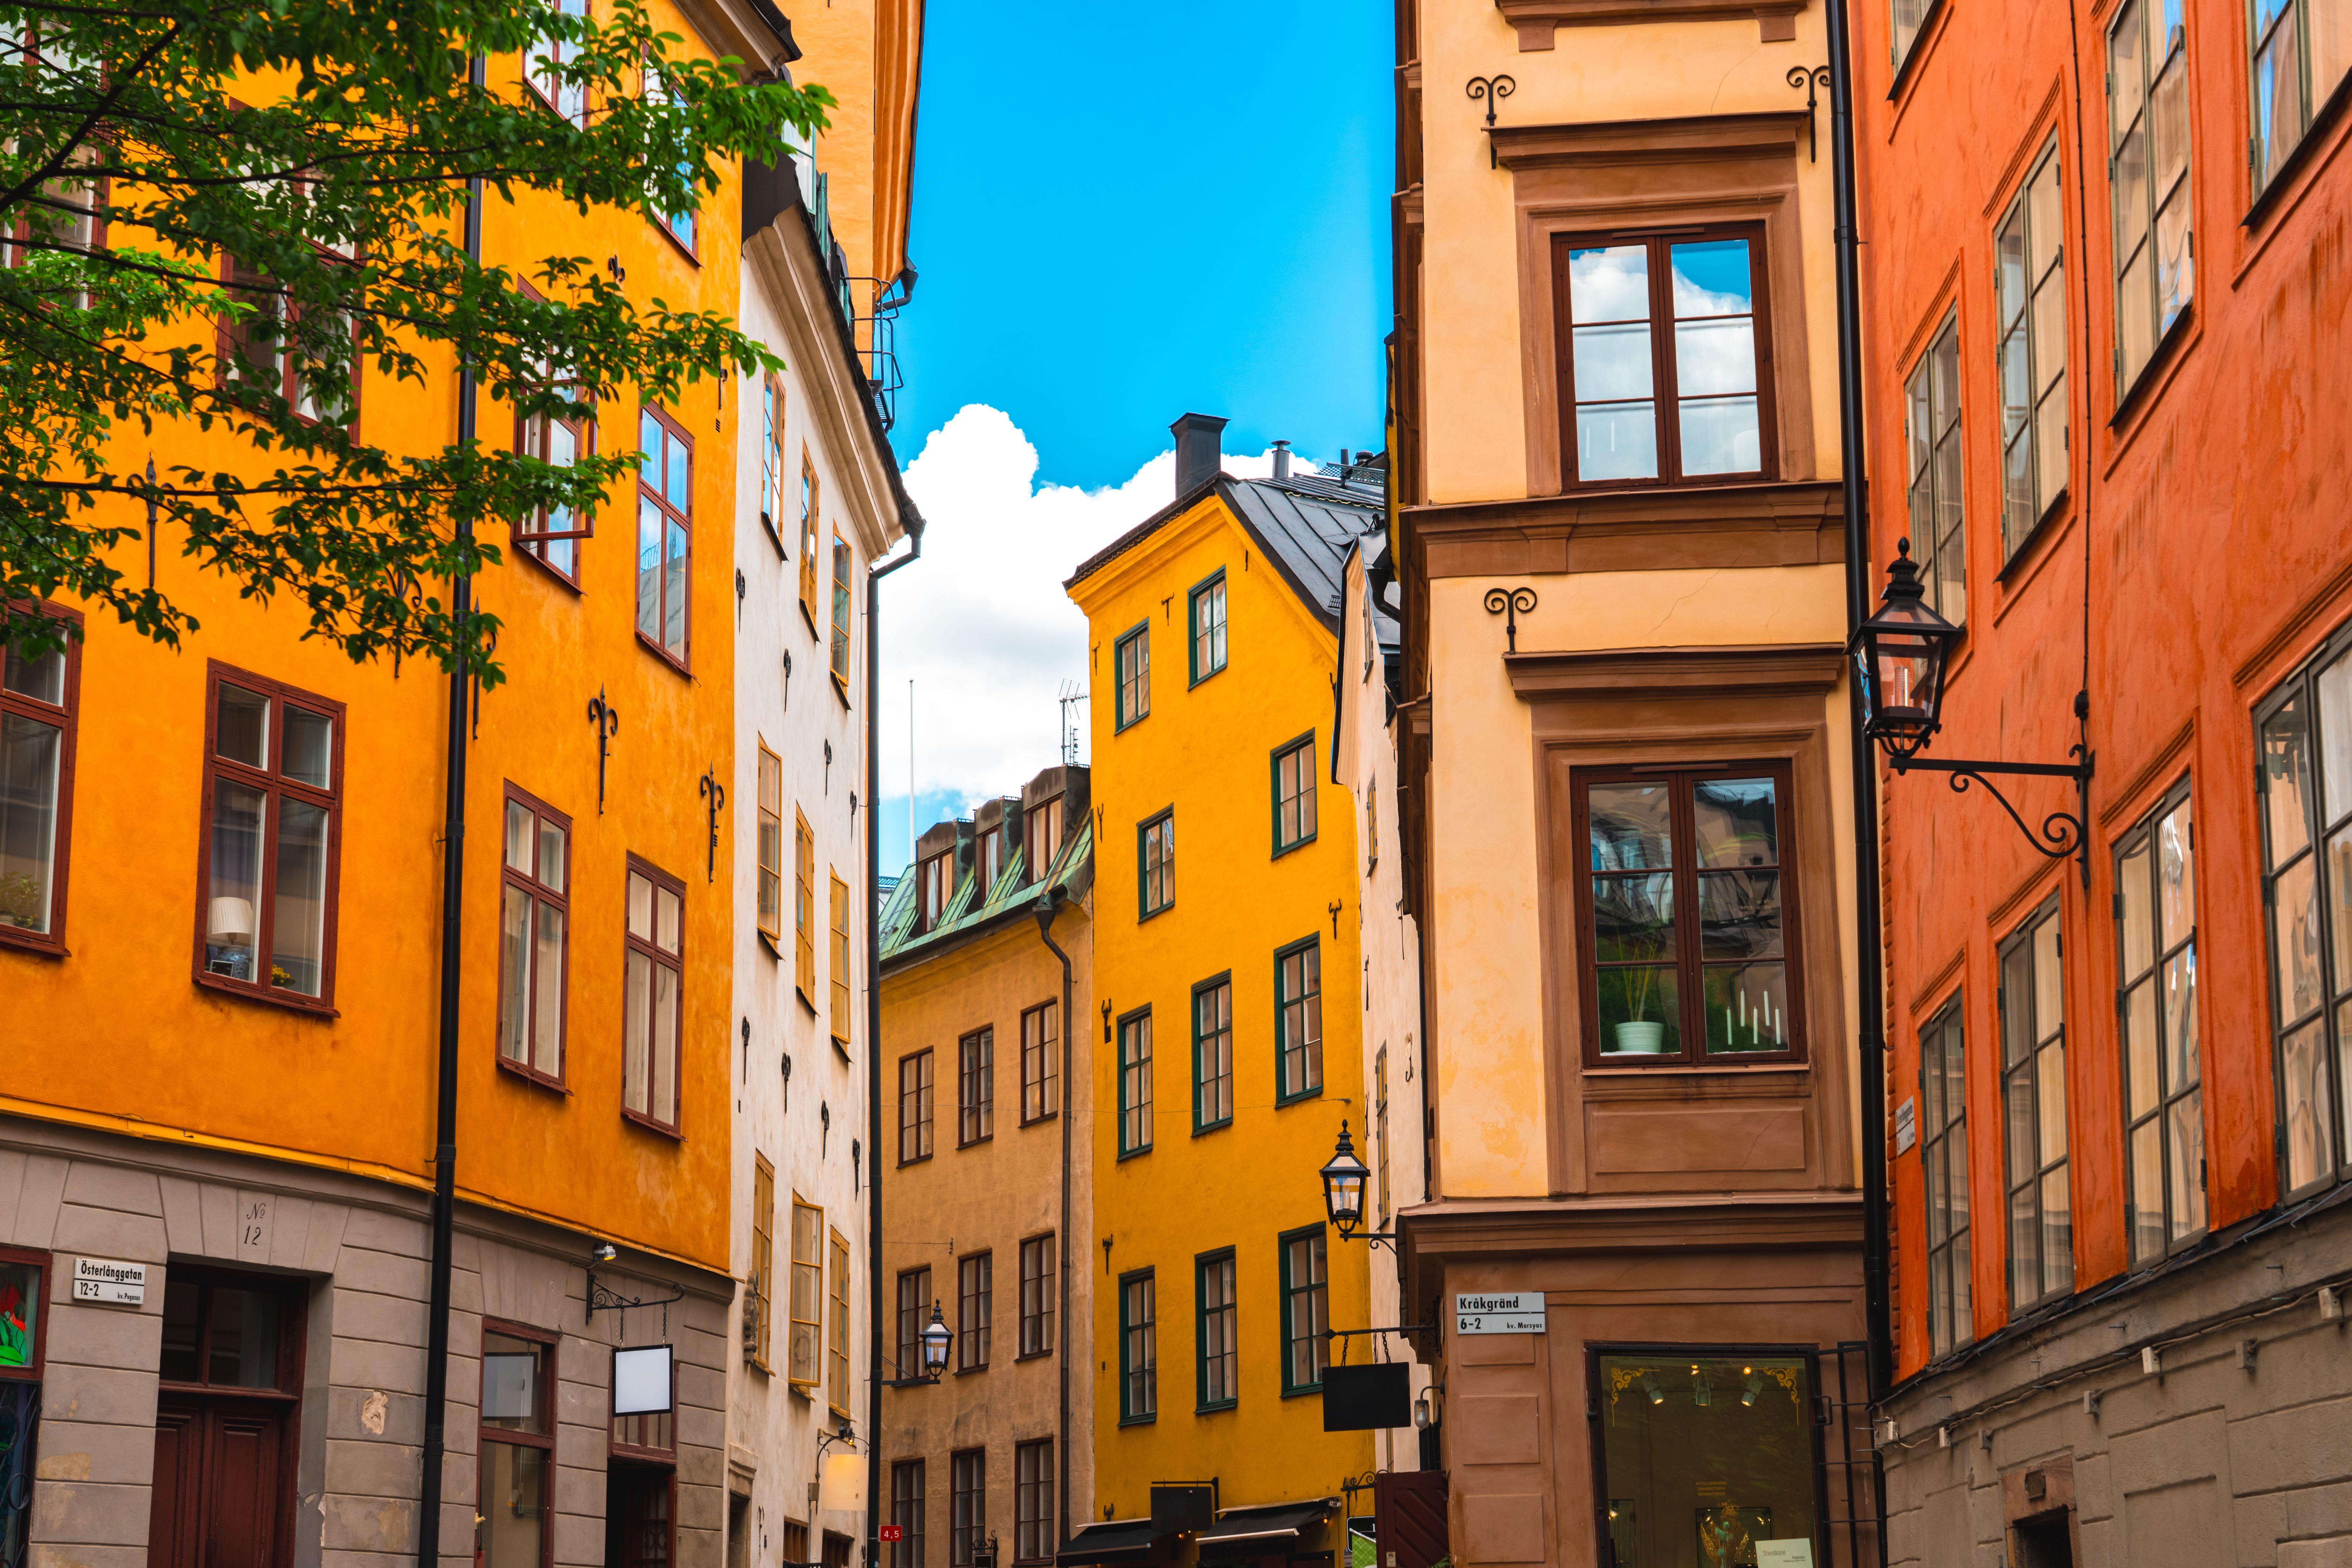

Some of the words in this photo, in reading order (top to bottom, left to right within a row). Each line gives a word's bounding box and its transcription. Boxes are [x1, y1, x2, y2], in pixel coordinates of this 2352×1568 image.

[244, 1225, 261, 1245] 12
[81, 1260, 142, 1281] Österlånggatan
[80, 1282, 99, 1296] 12-2
[124, 1293, 140, 1302] Pegasus
[1460, 1296, 1519, 1311] Kråkgränd
[1460, 1317, 1481, 1330] 6-2
[884, 1530, 899, 1539] 4,5
